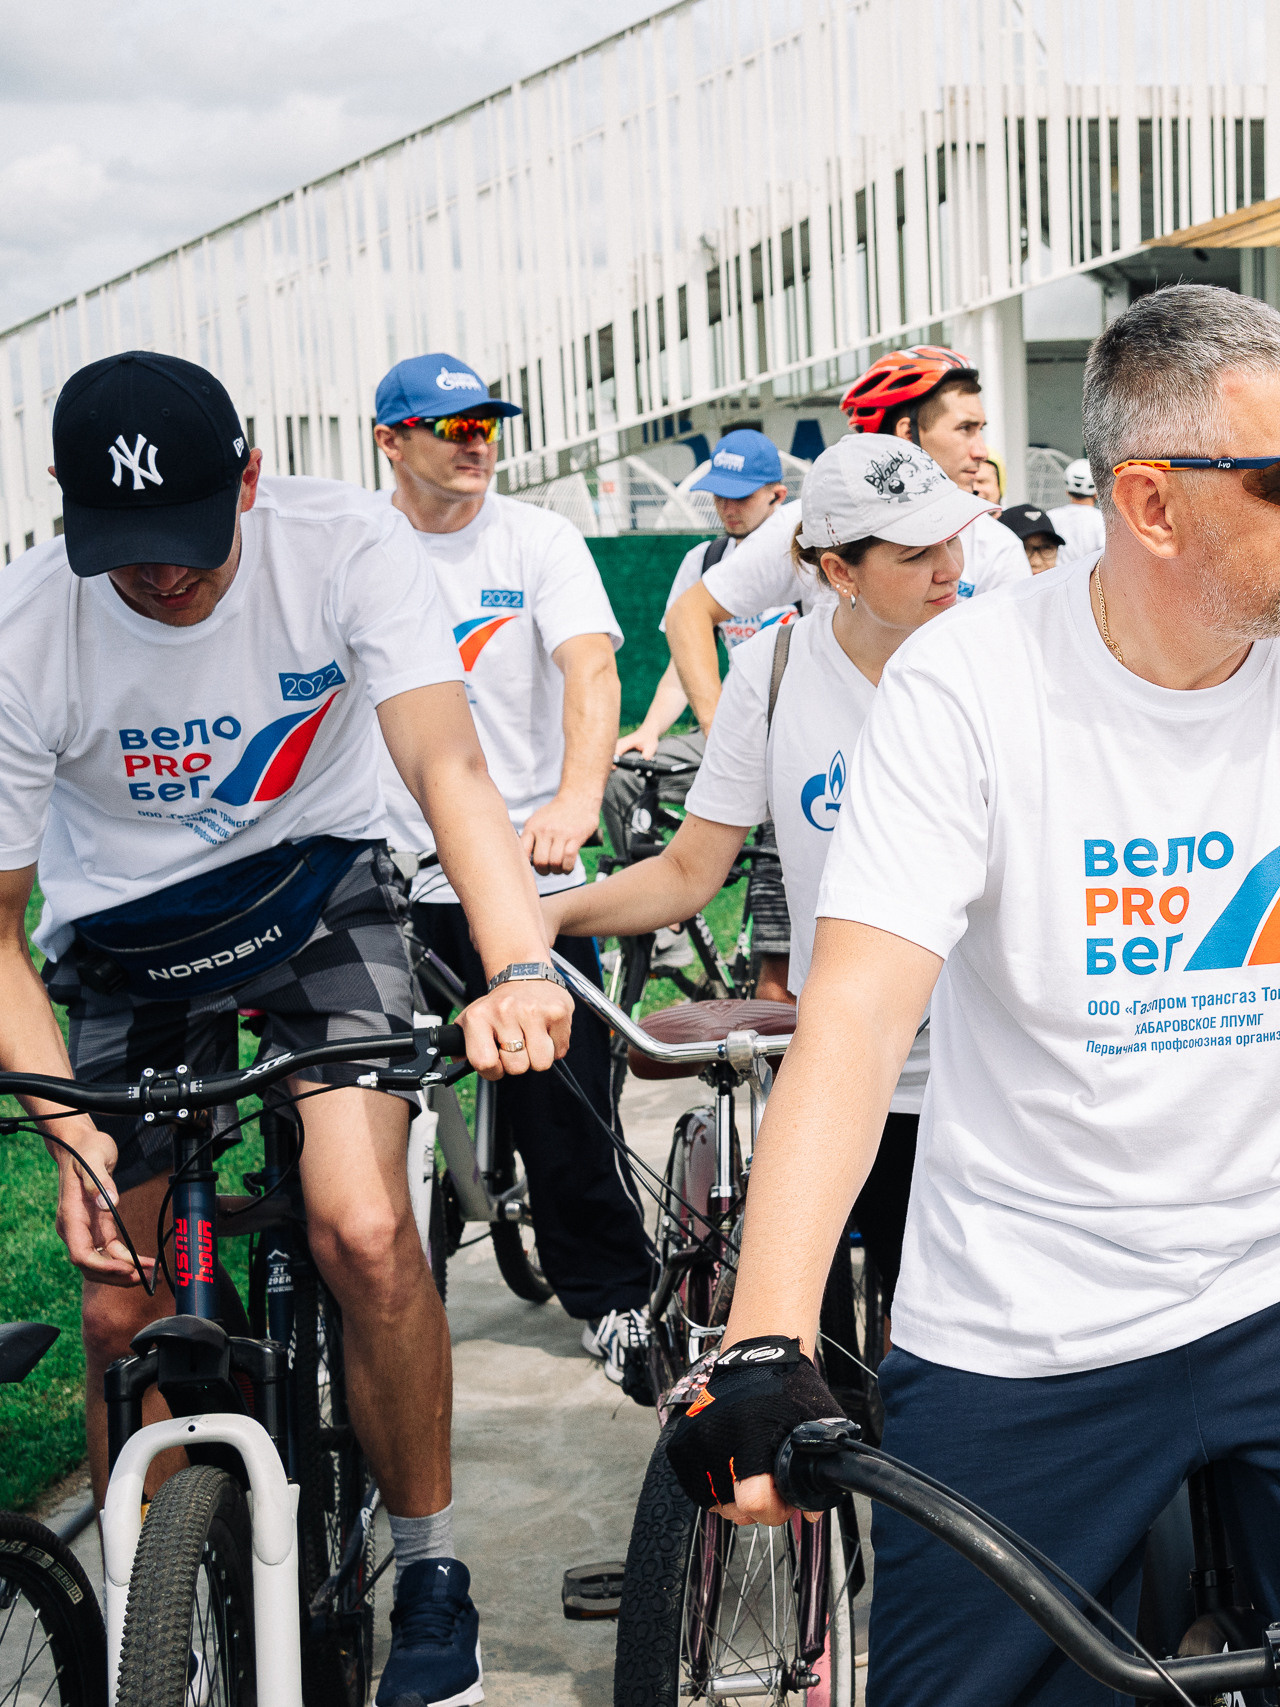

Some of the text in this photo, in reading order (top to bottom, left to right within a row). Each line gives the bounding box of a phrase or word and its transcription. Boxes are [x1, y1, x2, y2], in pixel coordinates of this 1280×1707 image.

[108, 433, 164, 490] NY
[482, 591, 522, 606] 2022
[284, 667, 341, 697] 2022
[124, 753, 212, 778] PRO
[1085, 886, 1190, 926] PRO
[147, 924, 282, 980] NORDSKI
[1087, 1000, 1120, 1015] ООО
[1125, 996, 1187, 1016] «Газпром
[1191, 990, 1256, 1010] трансгаз
[1134, 1013, 1264, 1036] ХАБАРОВСКОЕ ЛПУМГ
[1086, 1039, 1147, 1056] Первичная
[1150, 1031, 1232, 1053] профсоюзная
